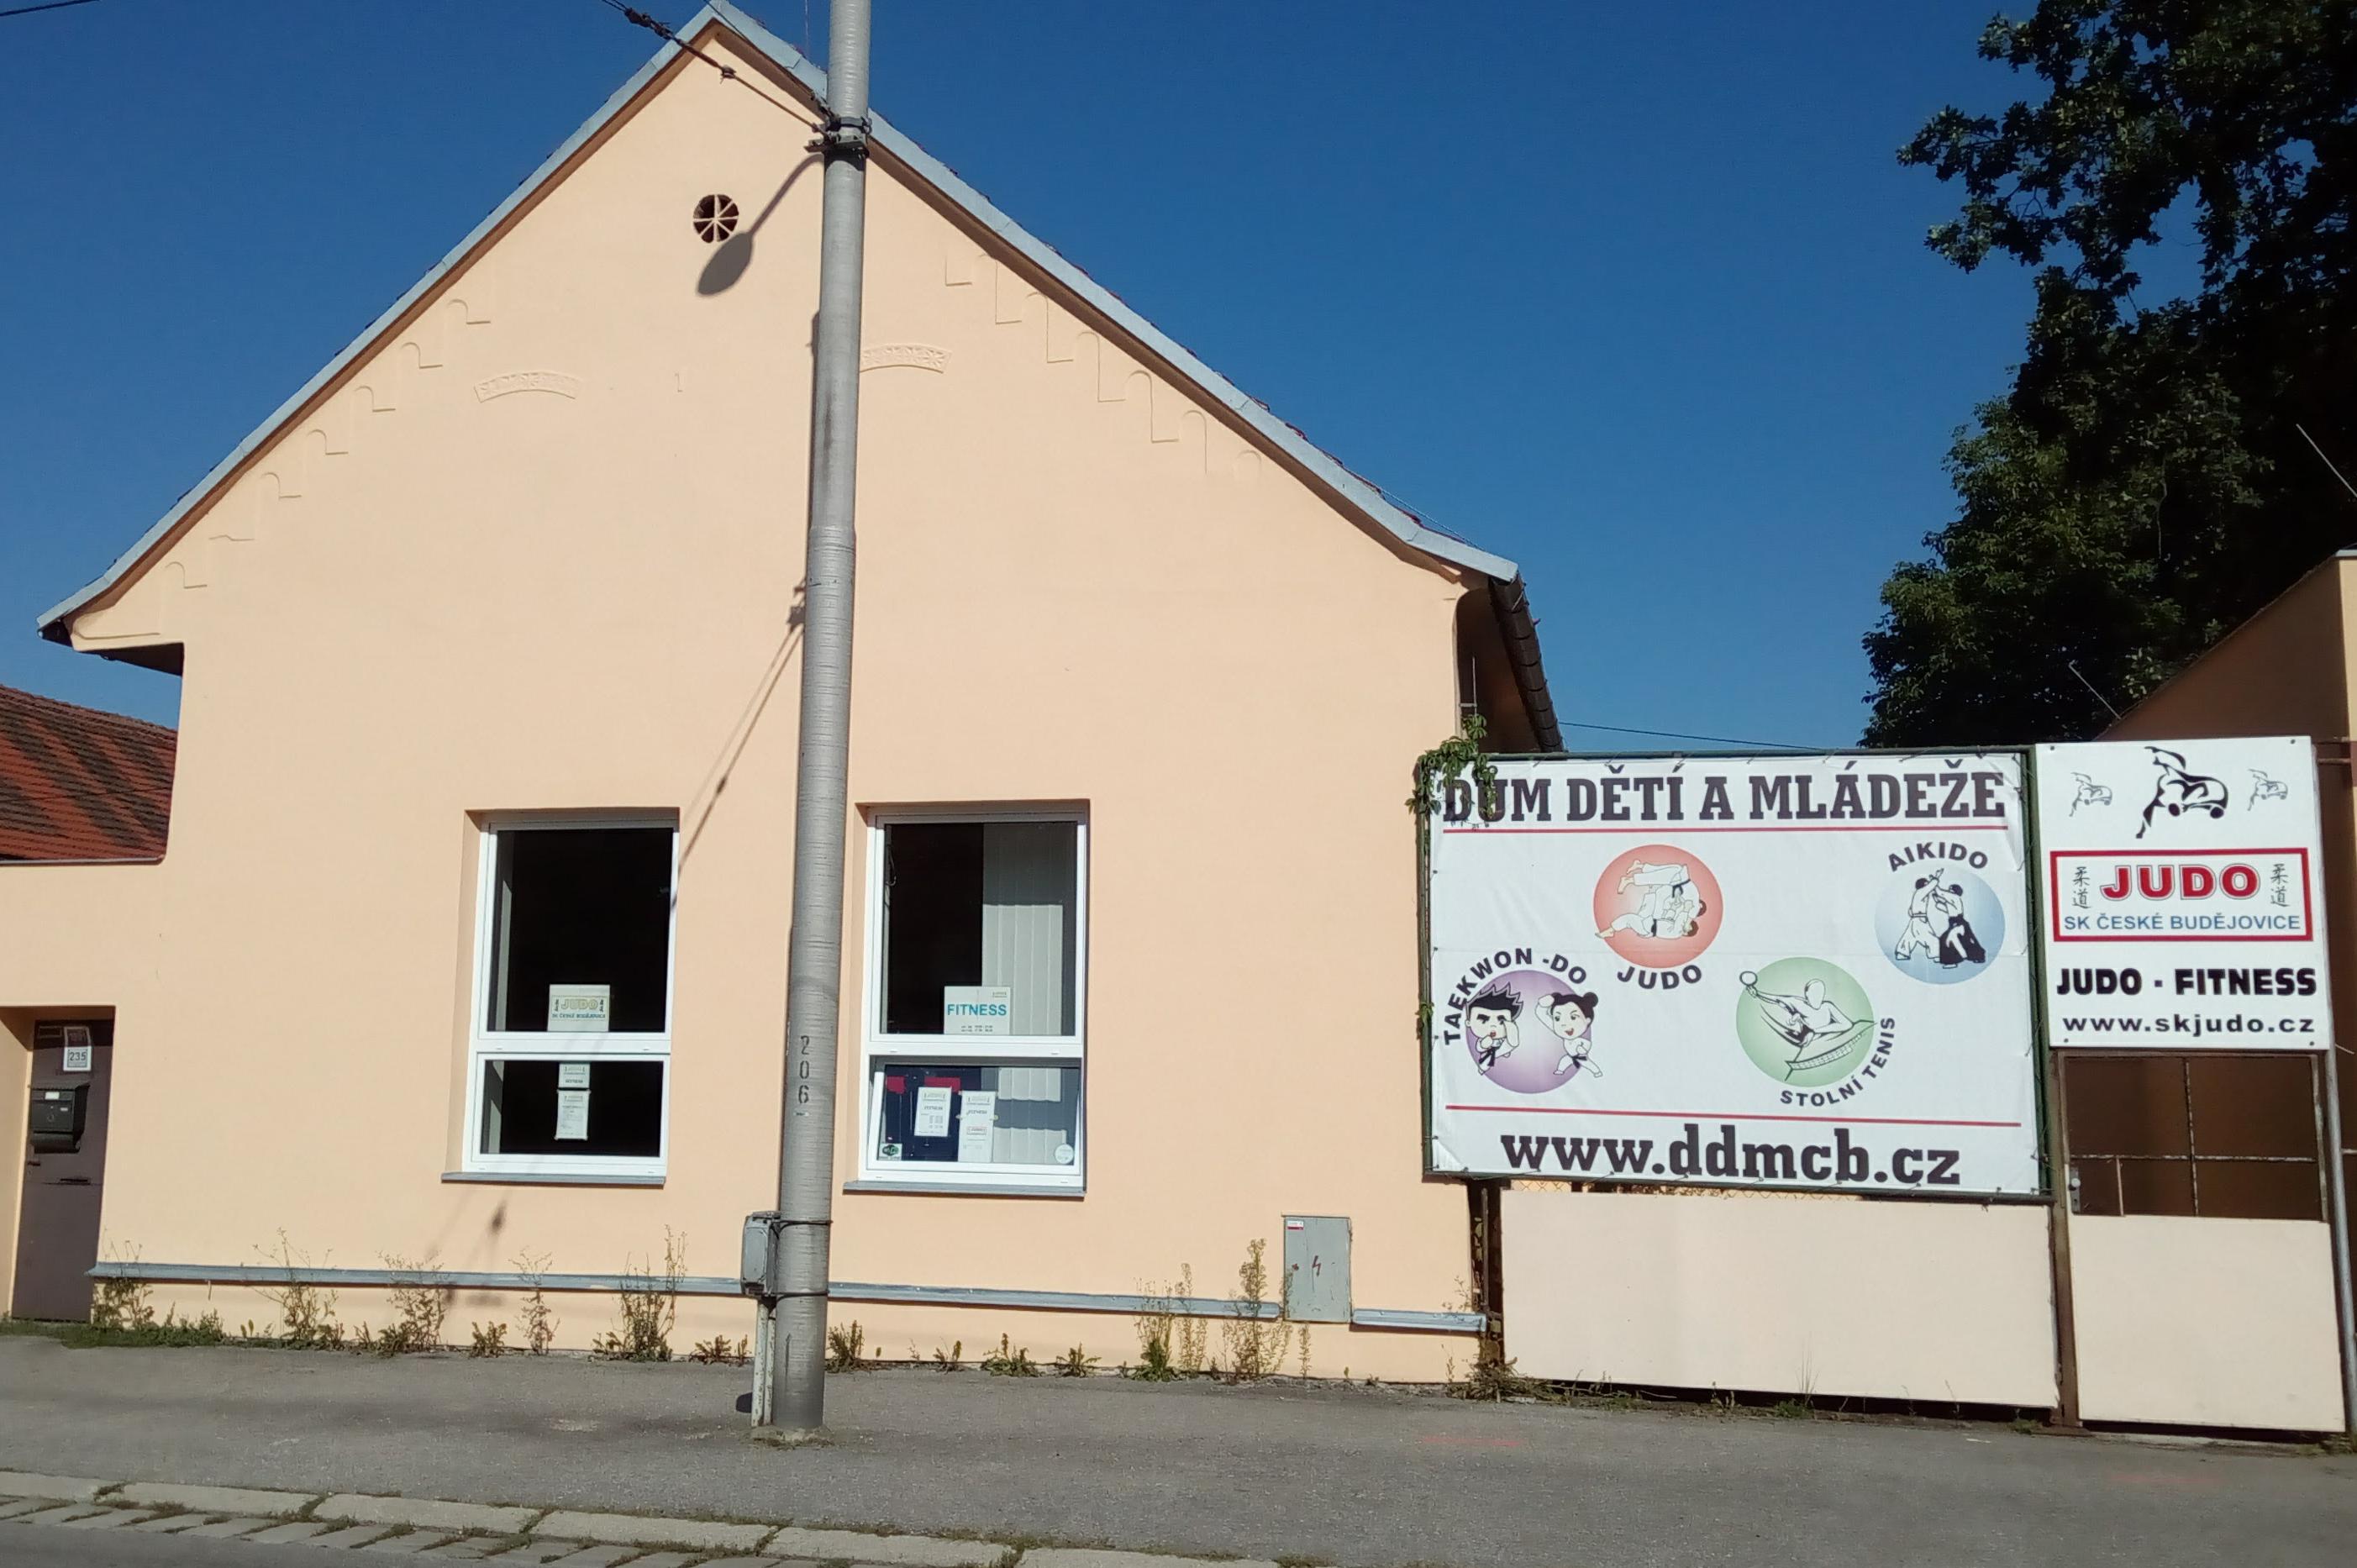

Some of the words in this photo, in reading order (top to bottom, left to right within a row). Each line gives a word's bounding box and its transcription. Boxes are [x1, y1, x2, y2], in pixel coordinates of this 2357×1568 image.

[1566, 763, 1685, 821] DĚTÍ
[1699, 776, 1735, 821] A
[1748, 758, 2006, 819] MLÁDEŽE
[1888, 841, 1989, 872] AIKIDO
[2100, 864, 2261, 901] JUDO
[2065, 916, 2091, 929] SK
[2097, 913, 2164, 929] ČESKÉ
[2170, 913, 2301, 929] BUDĚJOVICE
[1617, 964, 1702, 990] JUDO
[2056, 968, 2143, 996] JUDO
[2174, 967, 2318, 996] FITNESS
[947, 1004, 1008, 1016] FITNESS
[2062, 1013, 2315, 1038] www.skjudo.cz
[70, 1051, 87, 1061] 235
[797, 1034, 810, 1104] 206
[1780, 1076, 1864, 1107] STOLNÍ
[1861, 1018, 1896, 1079] TENIS
[1500, 1123, 1960, 1185] www.ddmcb.cz
